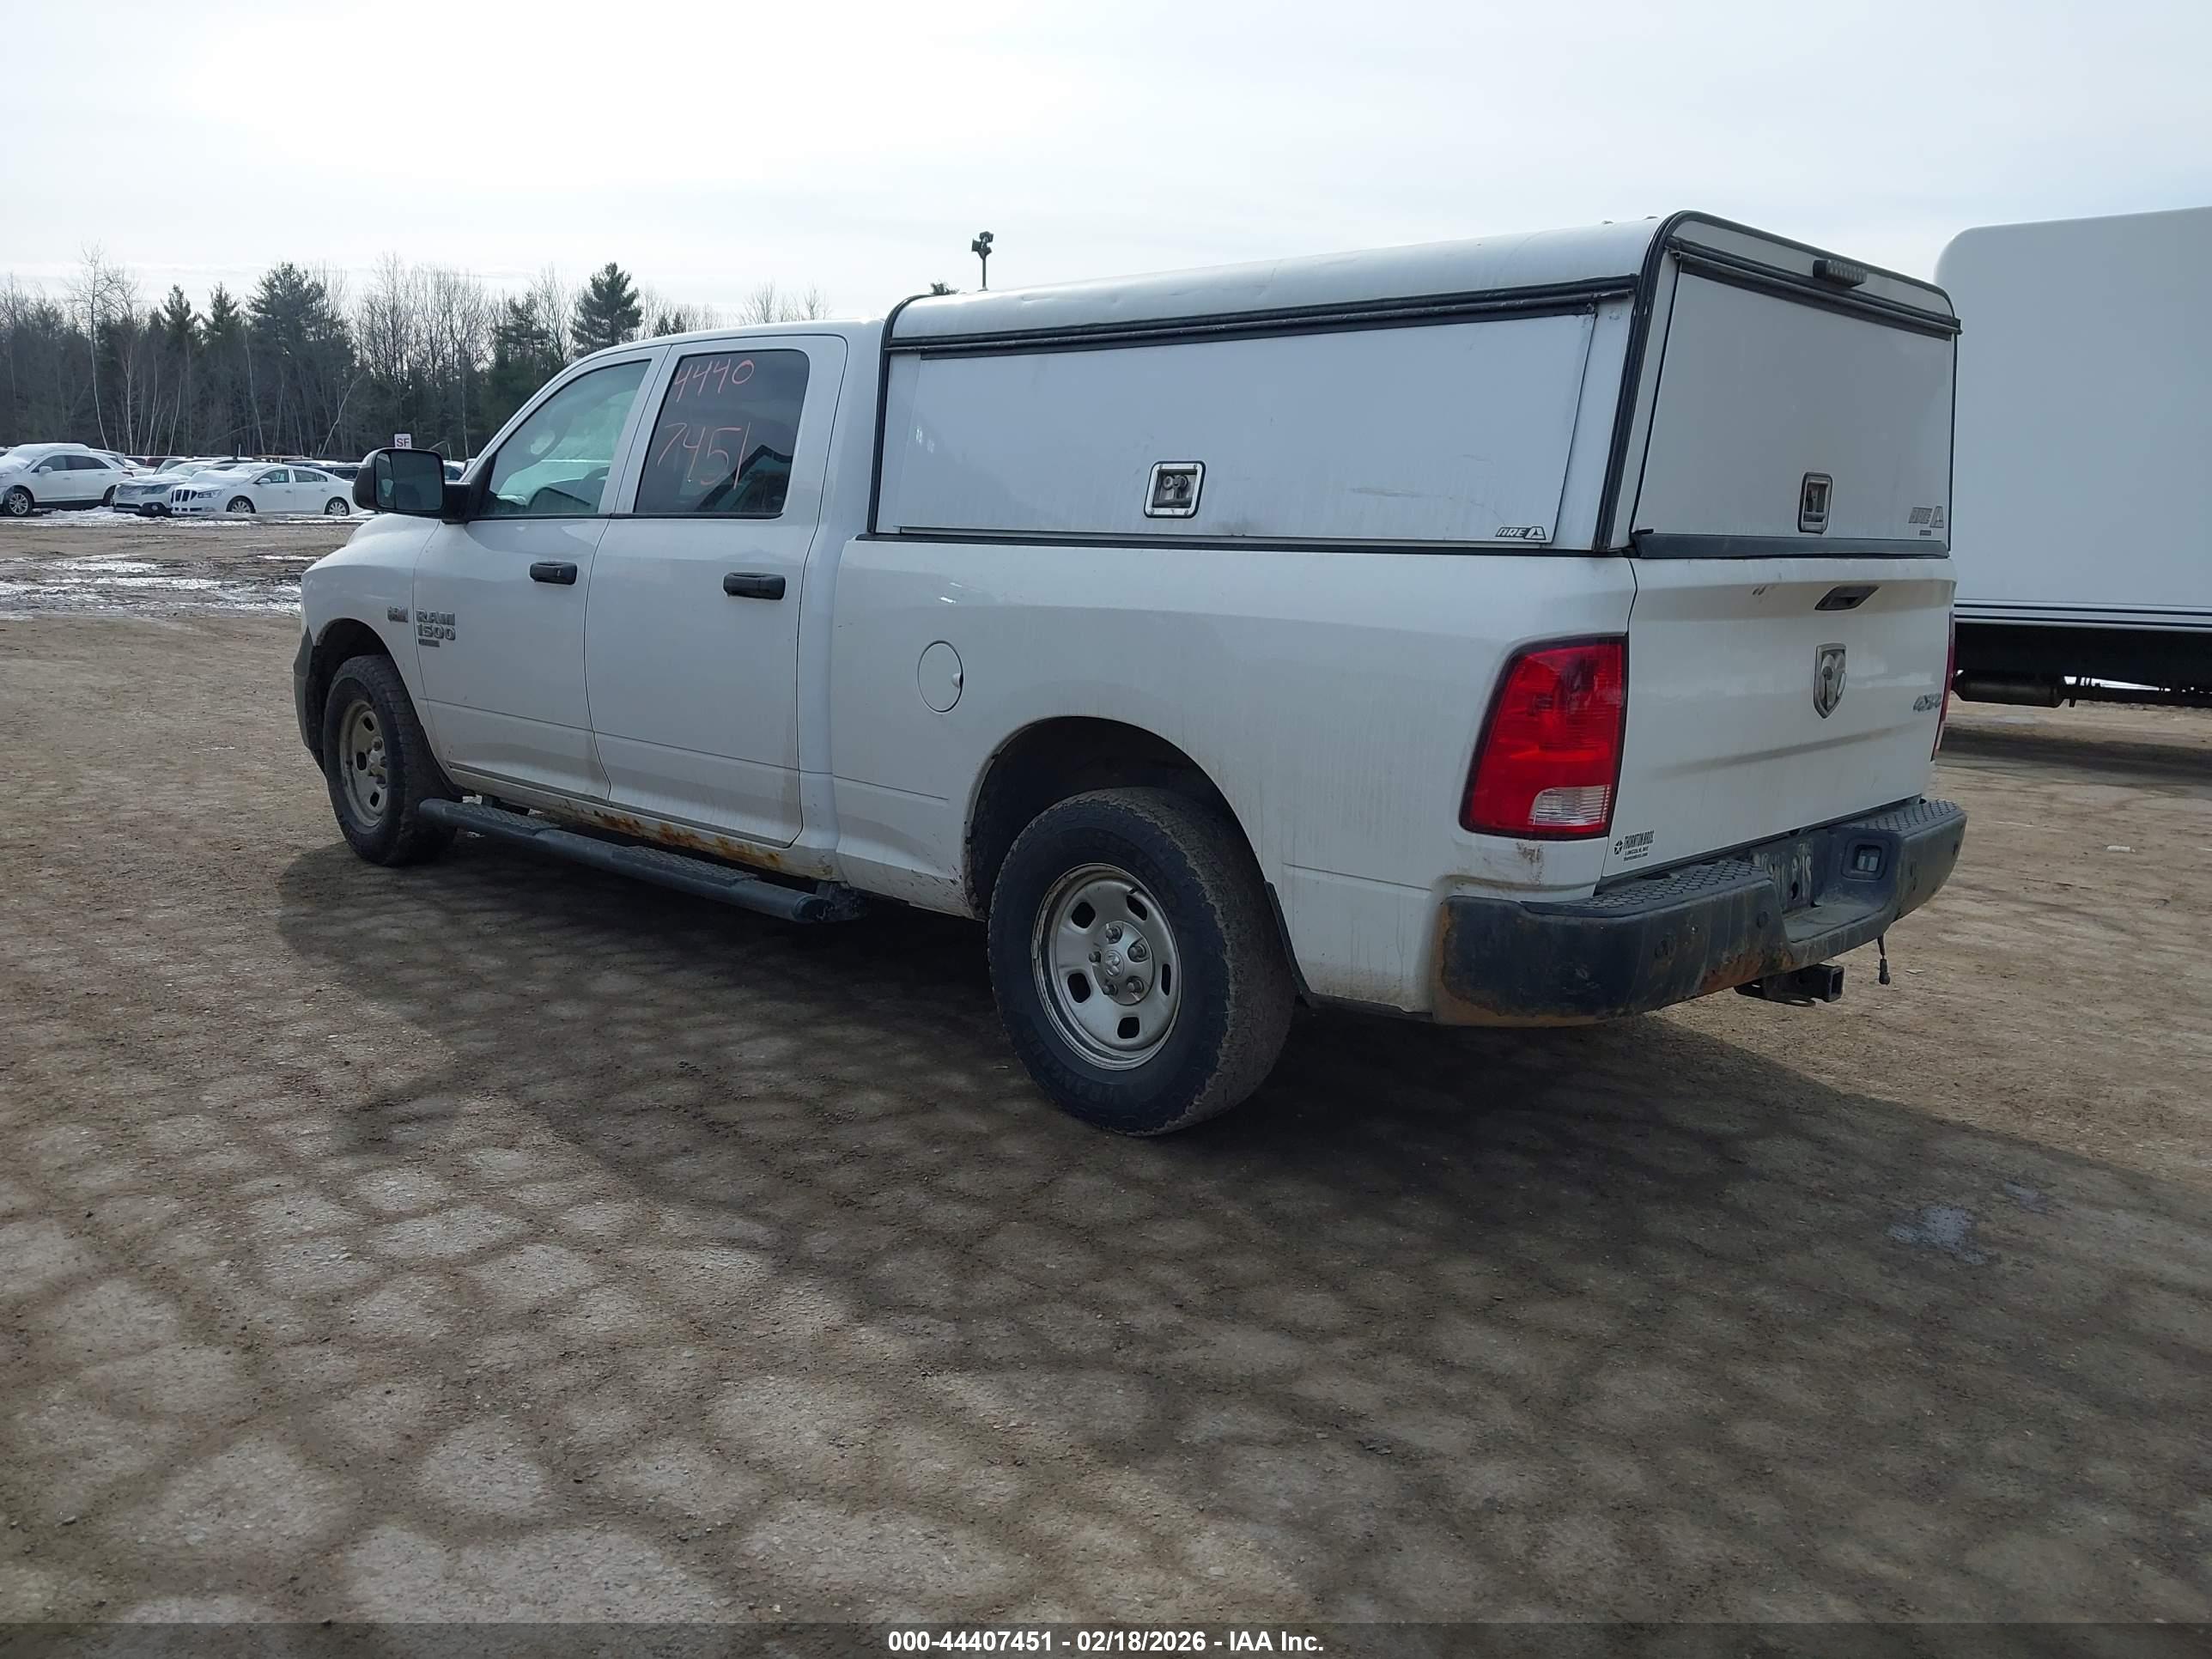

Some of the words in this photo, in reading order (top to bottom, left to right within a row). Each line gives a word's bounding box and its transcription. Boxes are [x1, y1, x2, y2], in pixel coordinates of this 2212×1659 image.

[674, 358, 755, 404] 4440
[396, 438, 410, 447] SF
[657, 421, 751, 490] 7451
[416, 609, 456, 626] RAM
[416, 623, 456, 641] 1500
